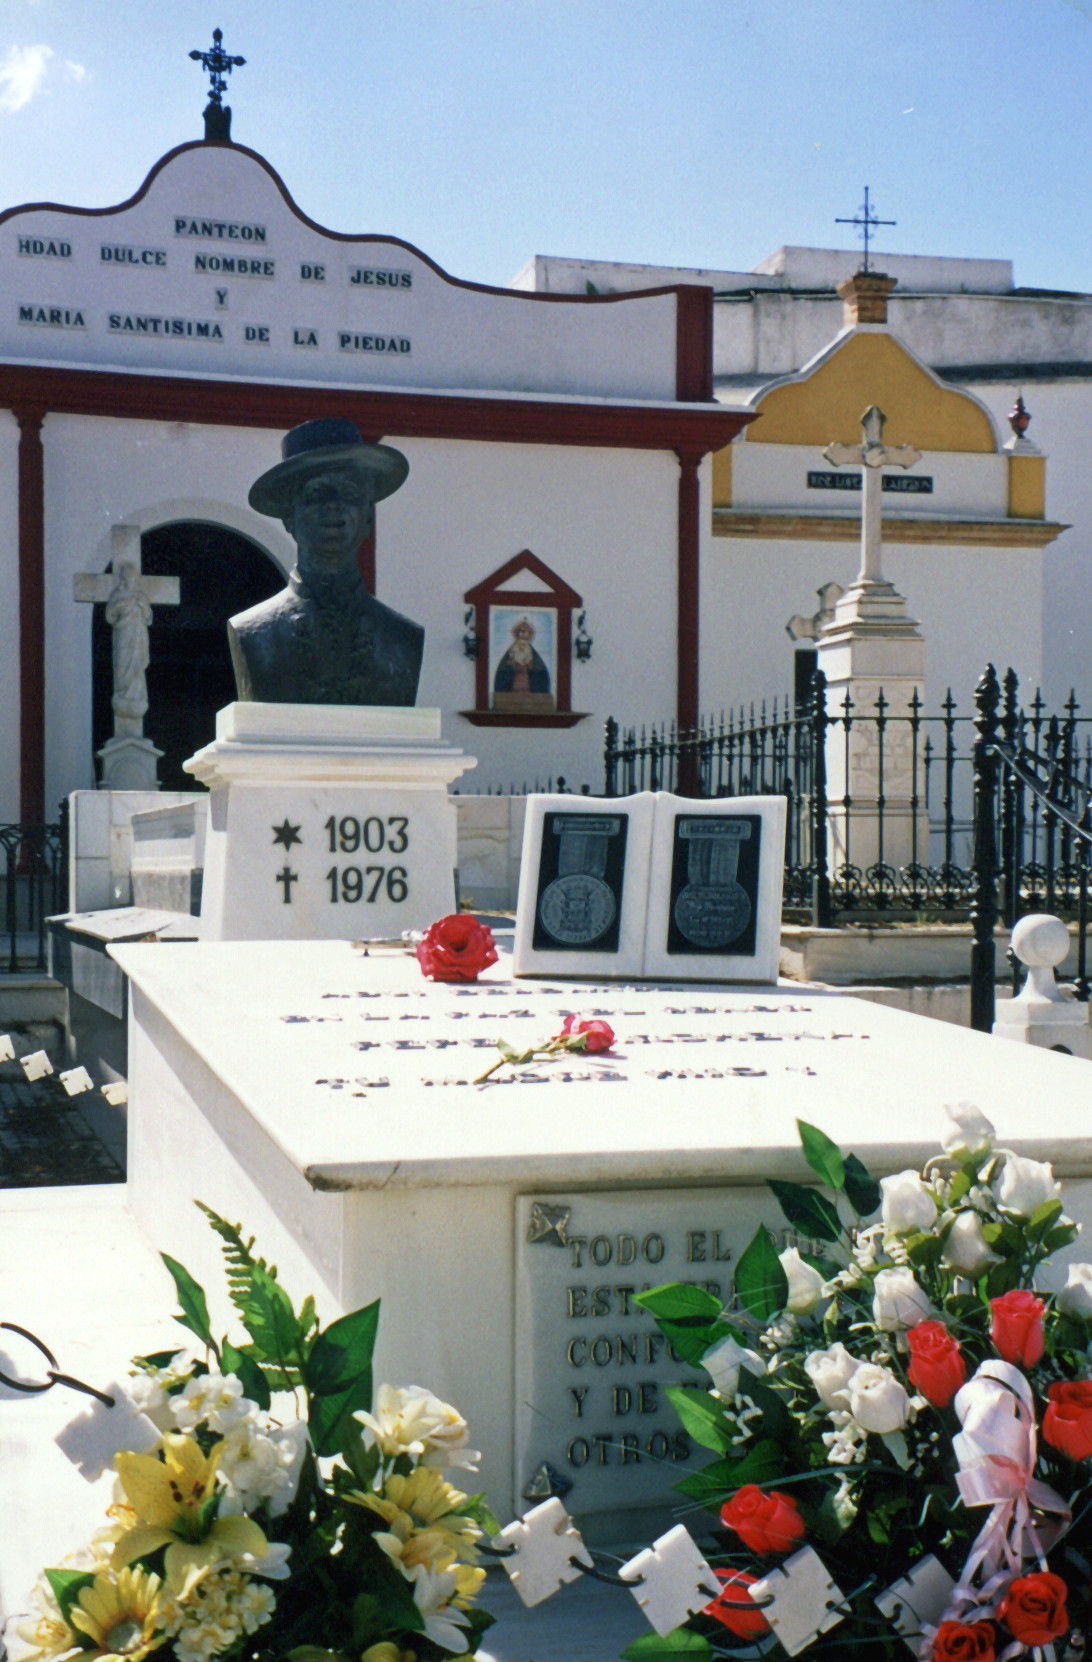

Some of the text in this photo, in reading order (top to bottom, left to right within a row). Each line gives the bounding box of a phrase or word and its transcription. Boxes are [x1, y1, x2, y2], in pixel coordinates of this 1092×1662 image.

[175, 219, 266, 241] PANTEON
[19, 239, 412, 288] HDAD DULCE NOMBRE DE JESUS
[215, 289, 228, 306] Y
[19, 307, 411, 353] MARIA SANTISIMA DE LA PIEDAD
[324, 815, 409, 853] 1903
[326, 866, 408, 903] 1976
[567, 1233, 665, 1268] TODO
[687, 1230, 731, 1262] EL
[569, 1387, 589, 1417] Y
[612, 1382, 659, 1416] DE
[567, 1430, 691, 1468] OTROS
